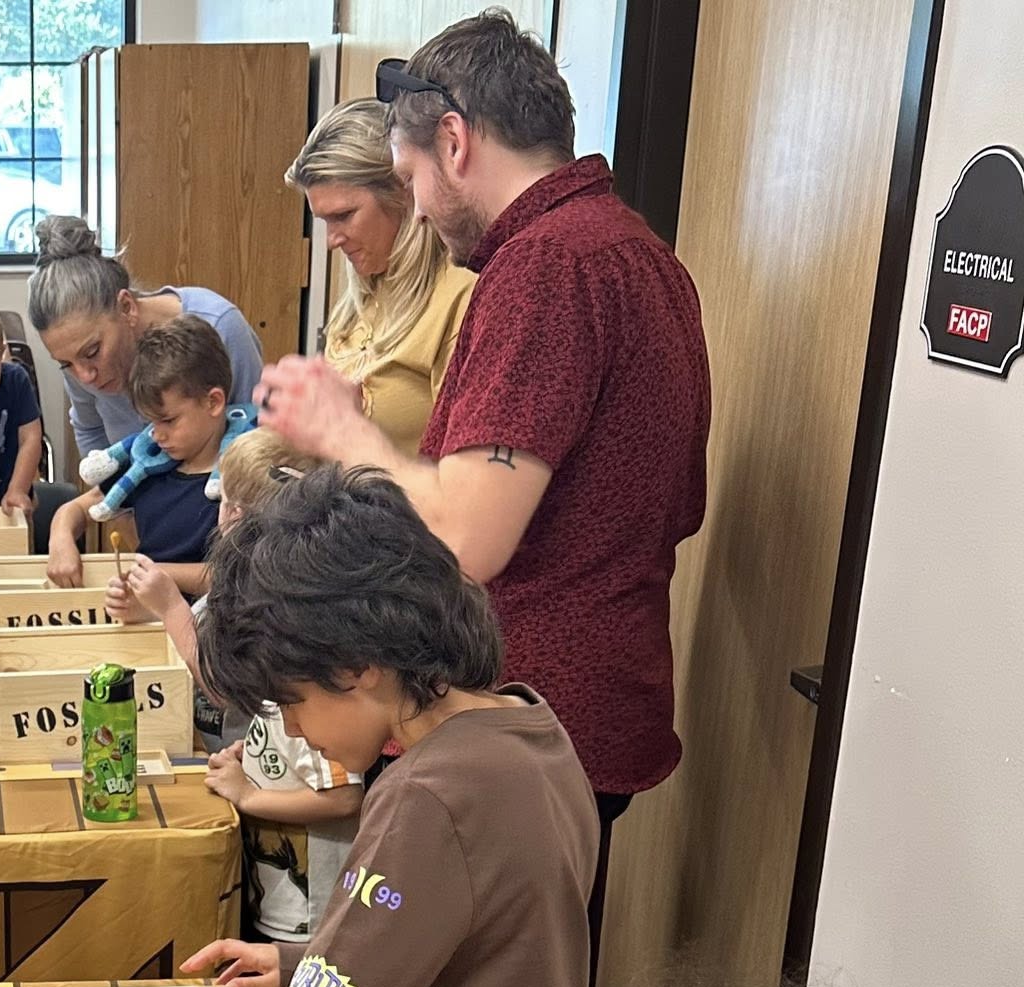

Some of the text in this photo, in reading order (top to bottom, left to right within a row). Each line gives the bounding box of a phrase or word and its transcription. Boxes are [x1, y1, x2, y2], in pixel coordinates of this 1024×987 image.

[943, 249, 1015, 283] ELECTRICAL
[948, 309, 988, 337] FACP
[7, 607, 119, 628] FOSSI
[12, 681, 165, 739] FOSS
